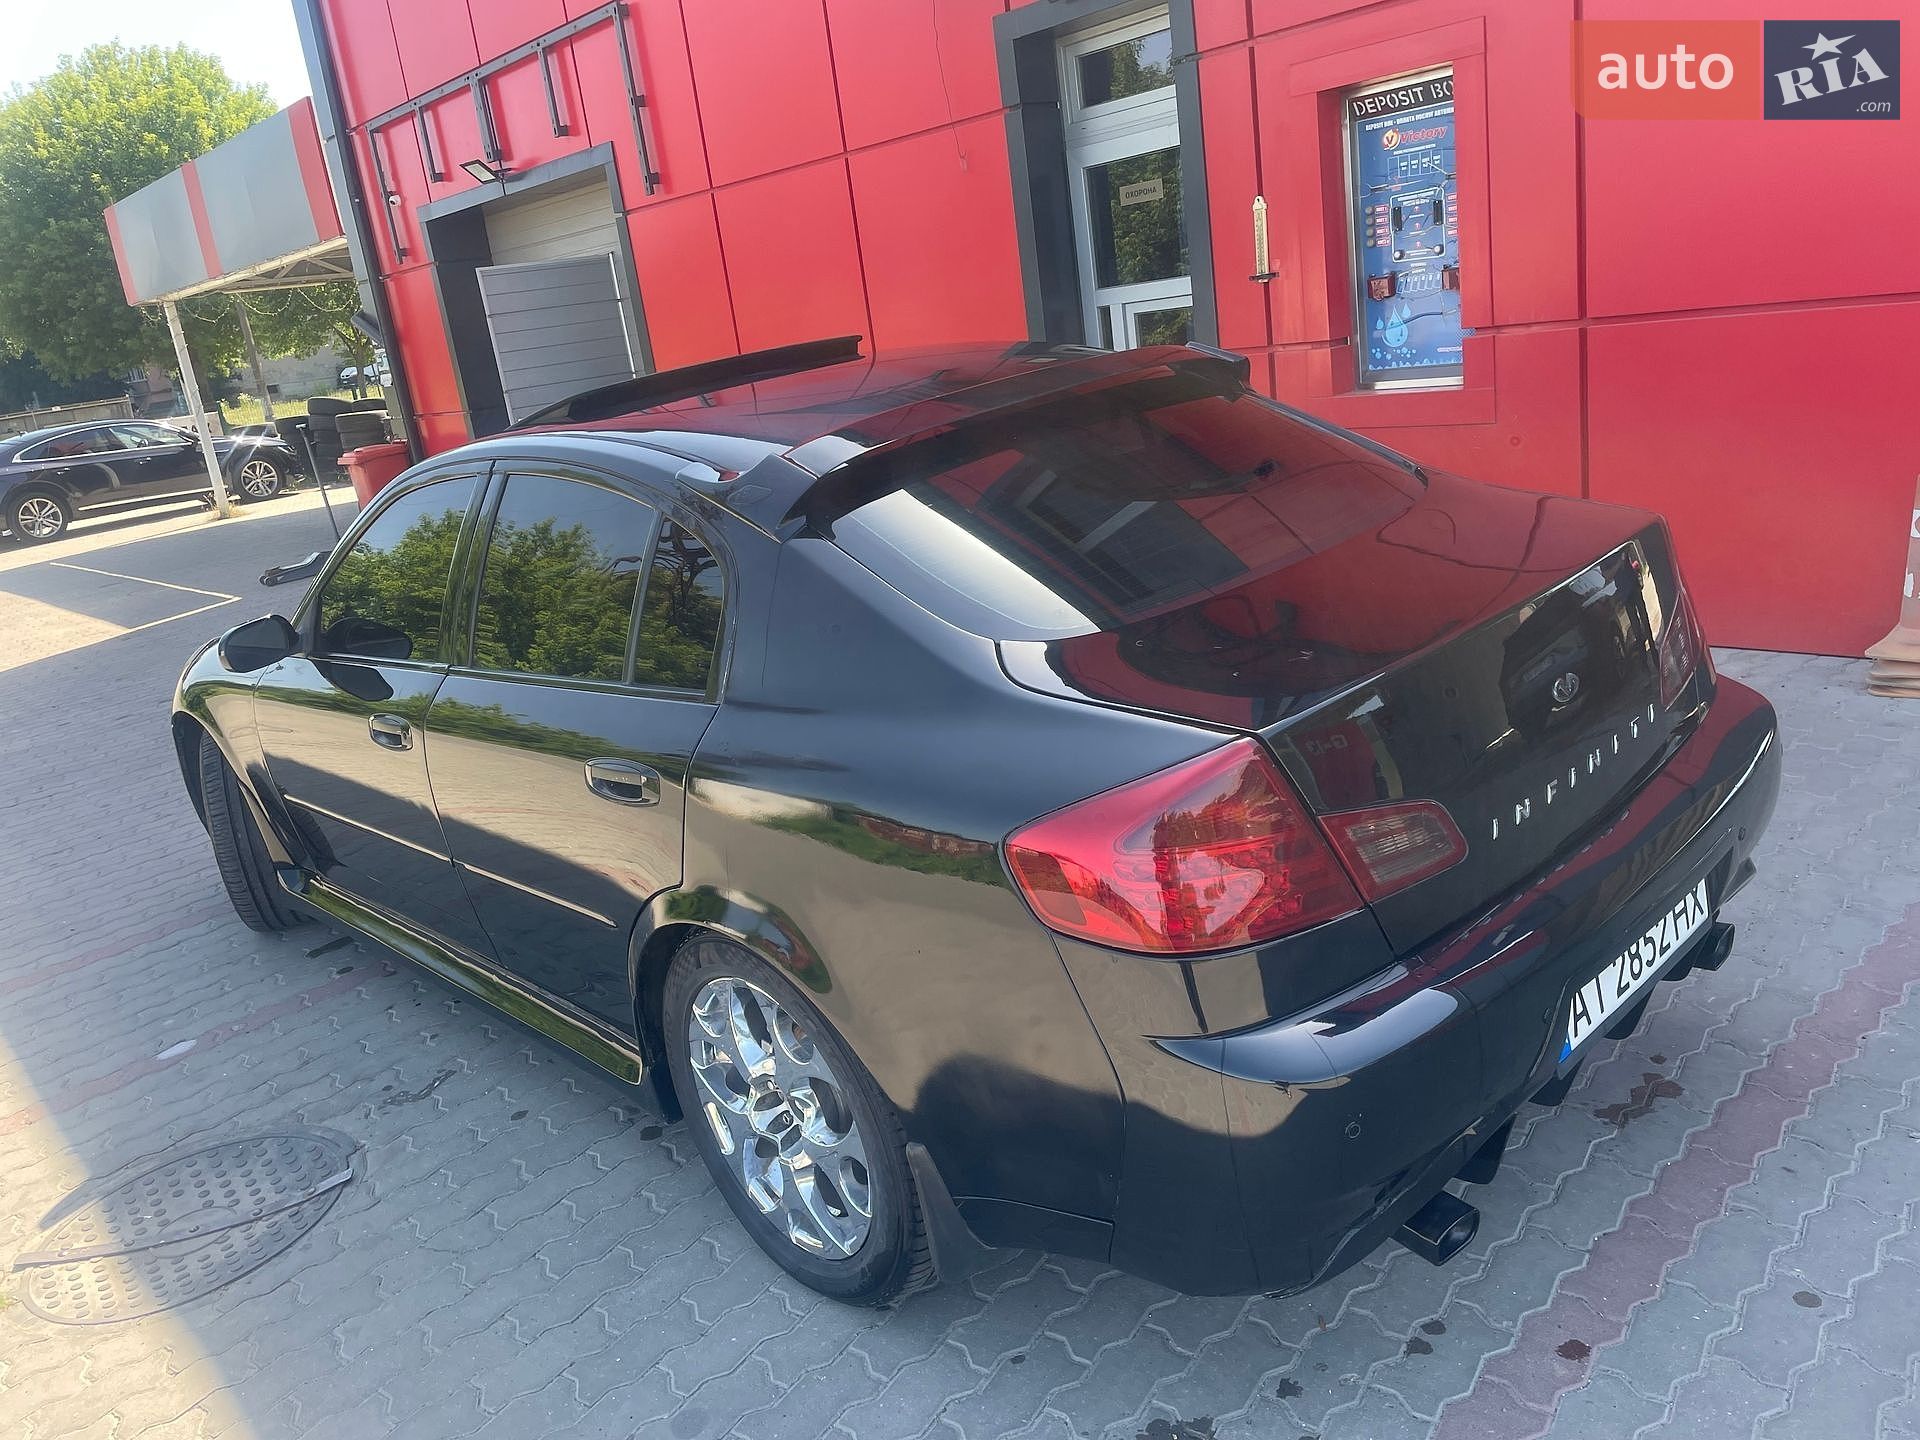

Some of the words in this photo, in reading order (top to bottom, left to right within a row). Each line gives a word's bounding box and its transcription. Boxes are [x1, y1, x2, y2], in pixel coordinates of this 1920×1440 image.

[1353, 87, 1424, 116] DEPOSIT
[1125, 186, 1157, 199] ОХОРОНА
[1491, 703, 1654, 840] INFINITI
